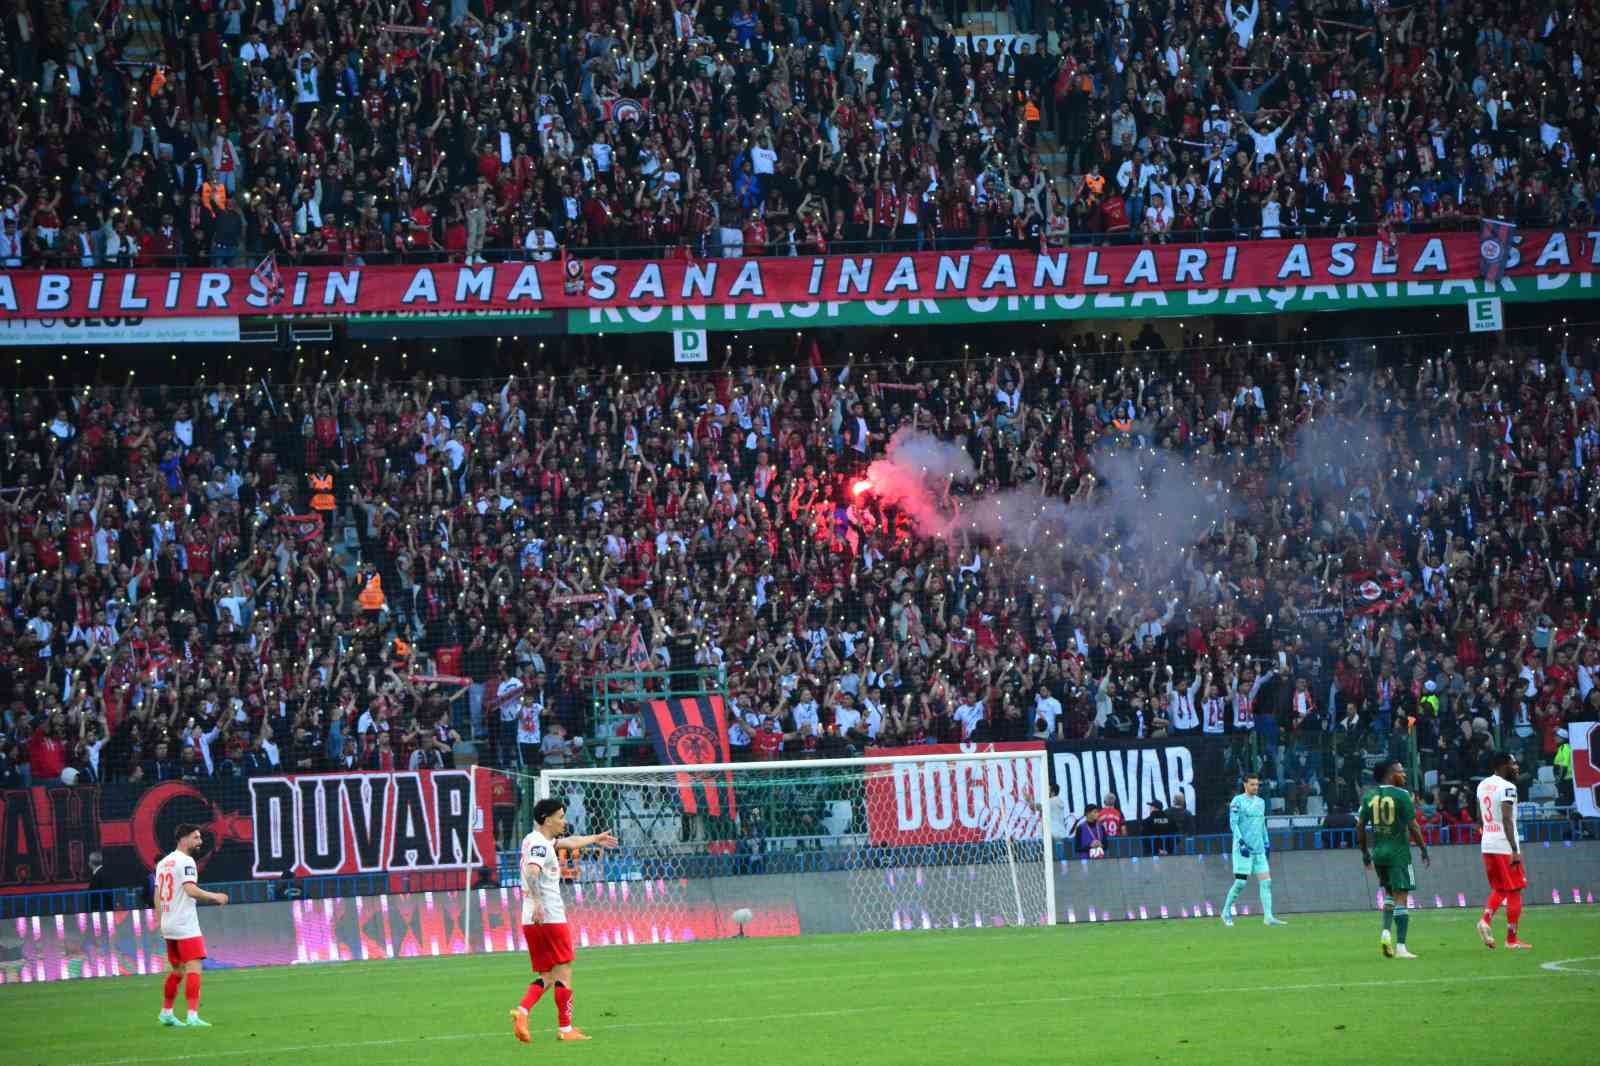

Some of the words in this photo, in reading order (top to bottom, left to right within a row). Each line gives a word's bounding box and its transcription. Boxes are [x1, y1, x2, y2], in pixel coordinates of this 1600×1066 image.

[401, 264, 545, 304] AMA
[587, 260, 765, 300] SANA
[1277, 238, 1449, 279] ASLA
[1476, 300, 1493, 321] E
[682, 331, 699, 351] D
[1053, 746, 1197, 822] DUVAR
[248, 769, 484, 879] DUVAR
[1368, 795, 1396, 826] 10
[1483, 795, 1494, 824] 3
[158, 872, 175, 903] 23
